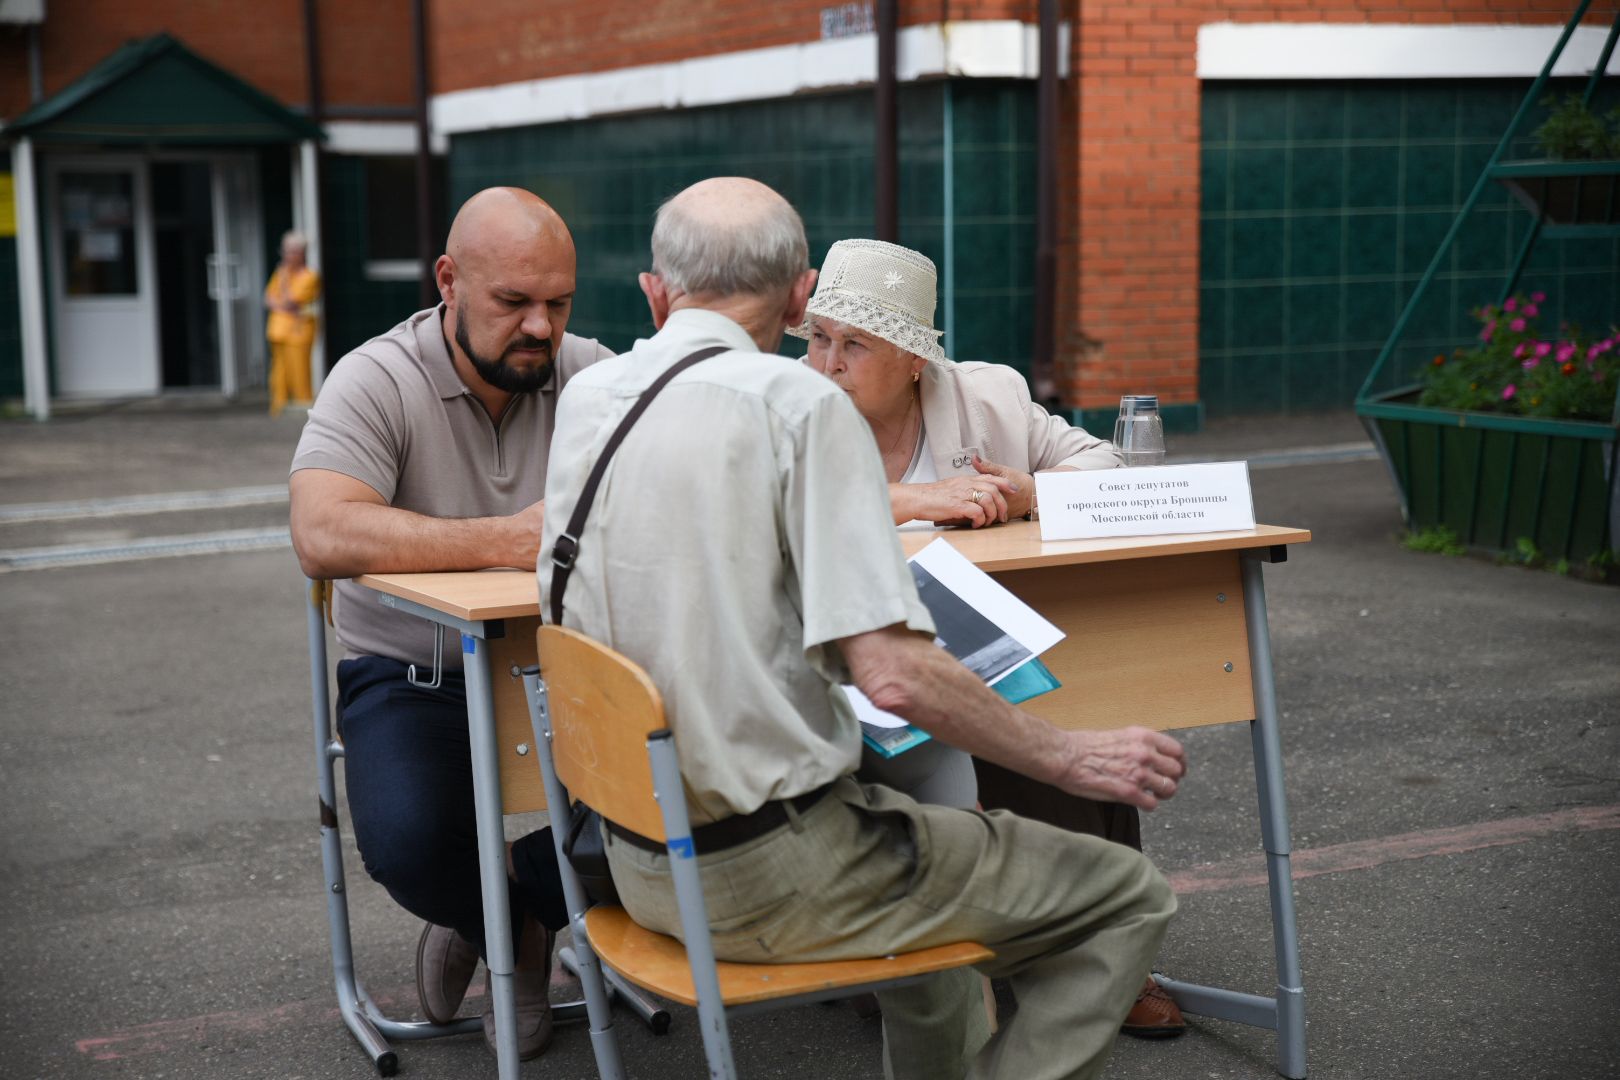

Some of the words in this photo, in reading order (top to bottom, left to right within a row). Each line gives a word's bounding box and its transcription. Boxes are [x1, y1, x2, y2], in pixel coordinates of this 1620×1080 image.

[1098, 482, 1131, 492] Совет
[1134, 480, 1189, 491] депутатов
[1066, 499, 1127, 511] городского
[1130, 498, 1167, 509] округа
[1170, 495, 1228, 506] Бронницы
[1091, 511, 1158, 524] Московской
[1161, 510, 1205, 520] области
